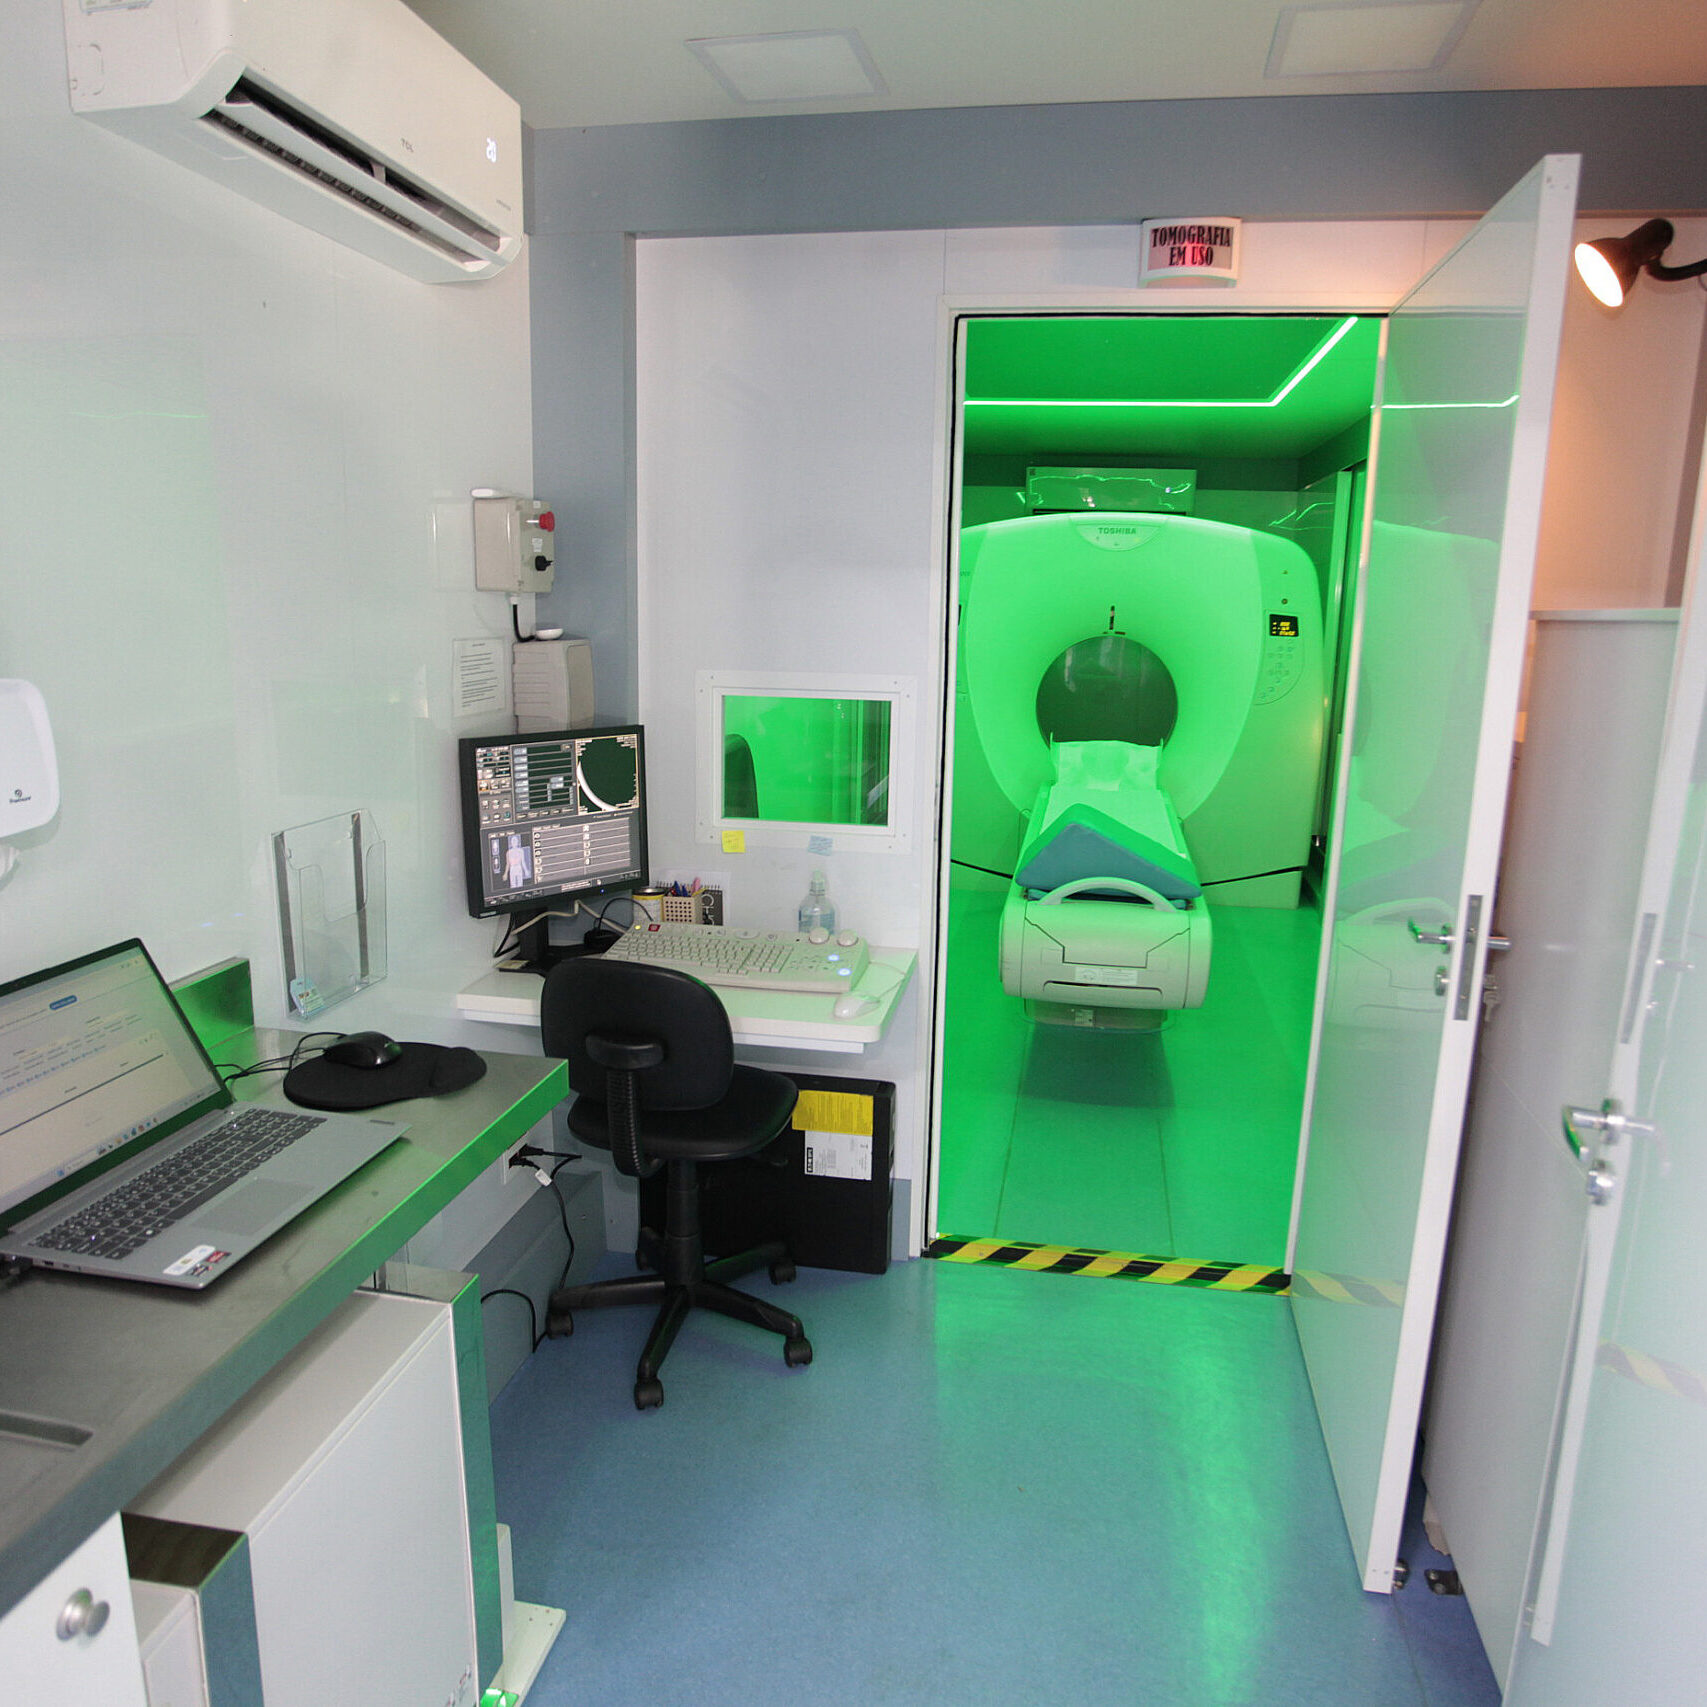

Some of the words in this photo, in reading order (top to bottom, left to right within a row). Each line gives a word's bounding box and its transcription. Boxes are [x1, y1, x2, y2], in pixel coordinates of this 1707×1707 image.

[1151, 226, 1231, 248] TOMOGRAFIA
[1169, 246, 1186, 266] EM
[1191, 246, 1214, 266] USO
[1098, 527, 1136, 535] TOSHIBA
